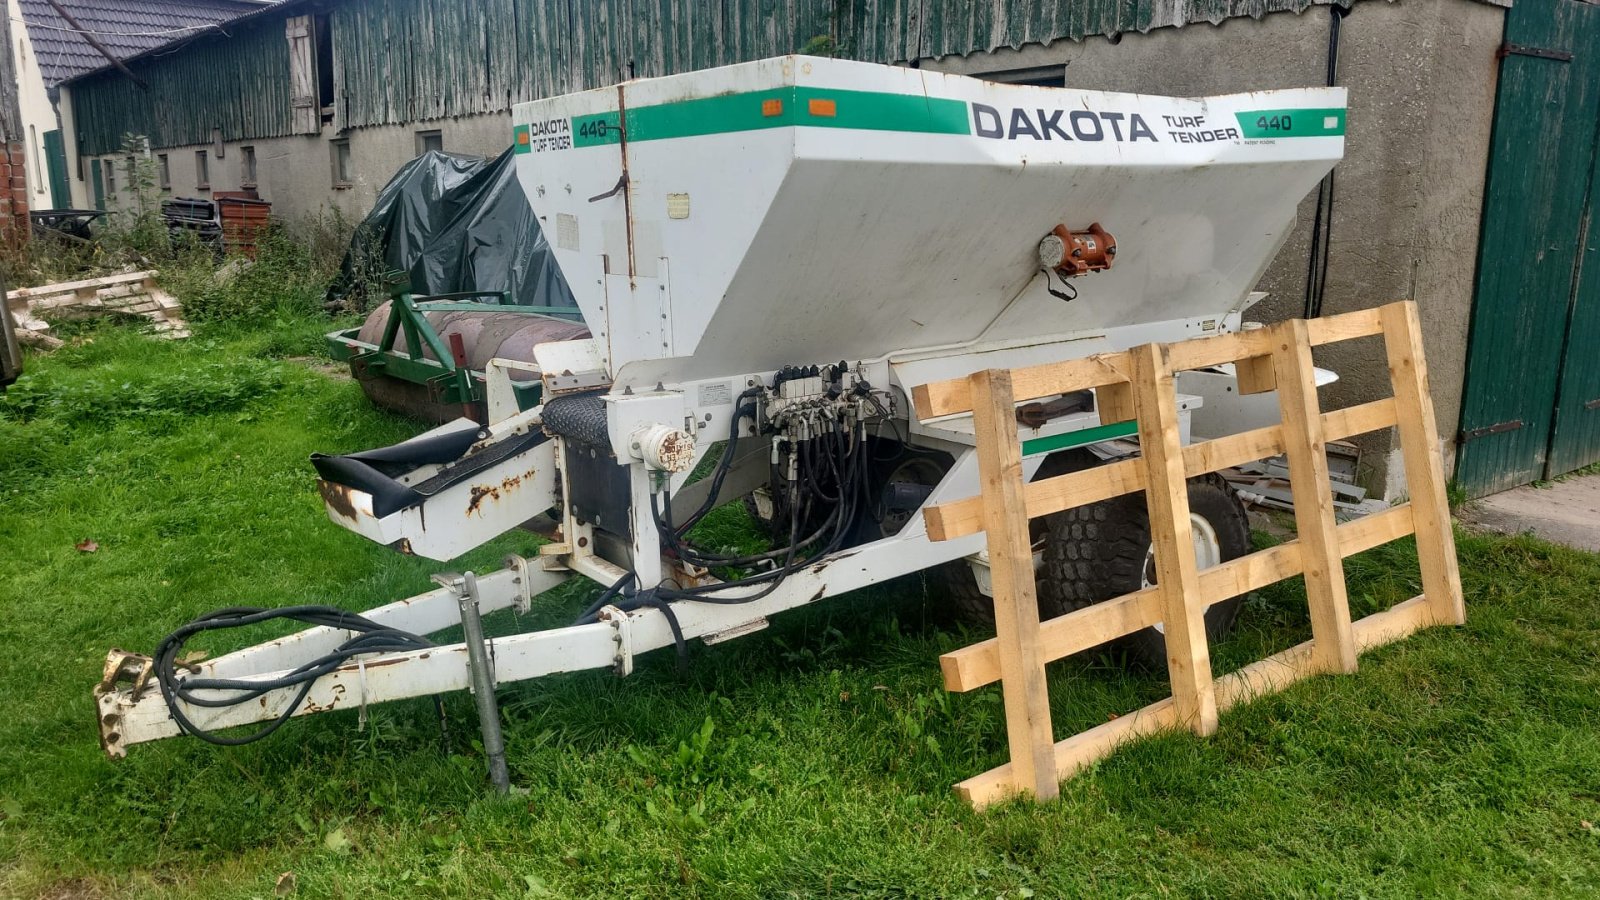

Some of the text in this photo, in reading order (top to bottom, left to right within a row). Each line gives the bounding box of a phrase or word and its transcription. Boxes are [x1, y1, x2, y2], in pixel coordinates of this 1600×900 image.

[531, 118, 570, 137] DAKOTA
[579, 120, 607, 138] 440
[972, 102, 1159, 142] DAKOTA
[1162, 115, 1205, 128] TURF
[1256, 115, 1292, 130] 440
[533, 135, 571, 152] TURF TENDER
[1168, 128, 1239, 143] TENDER
